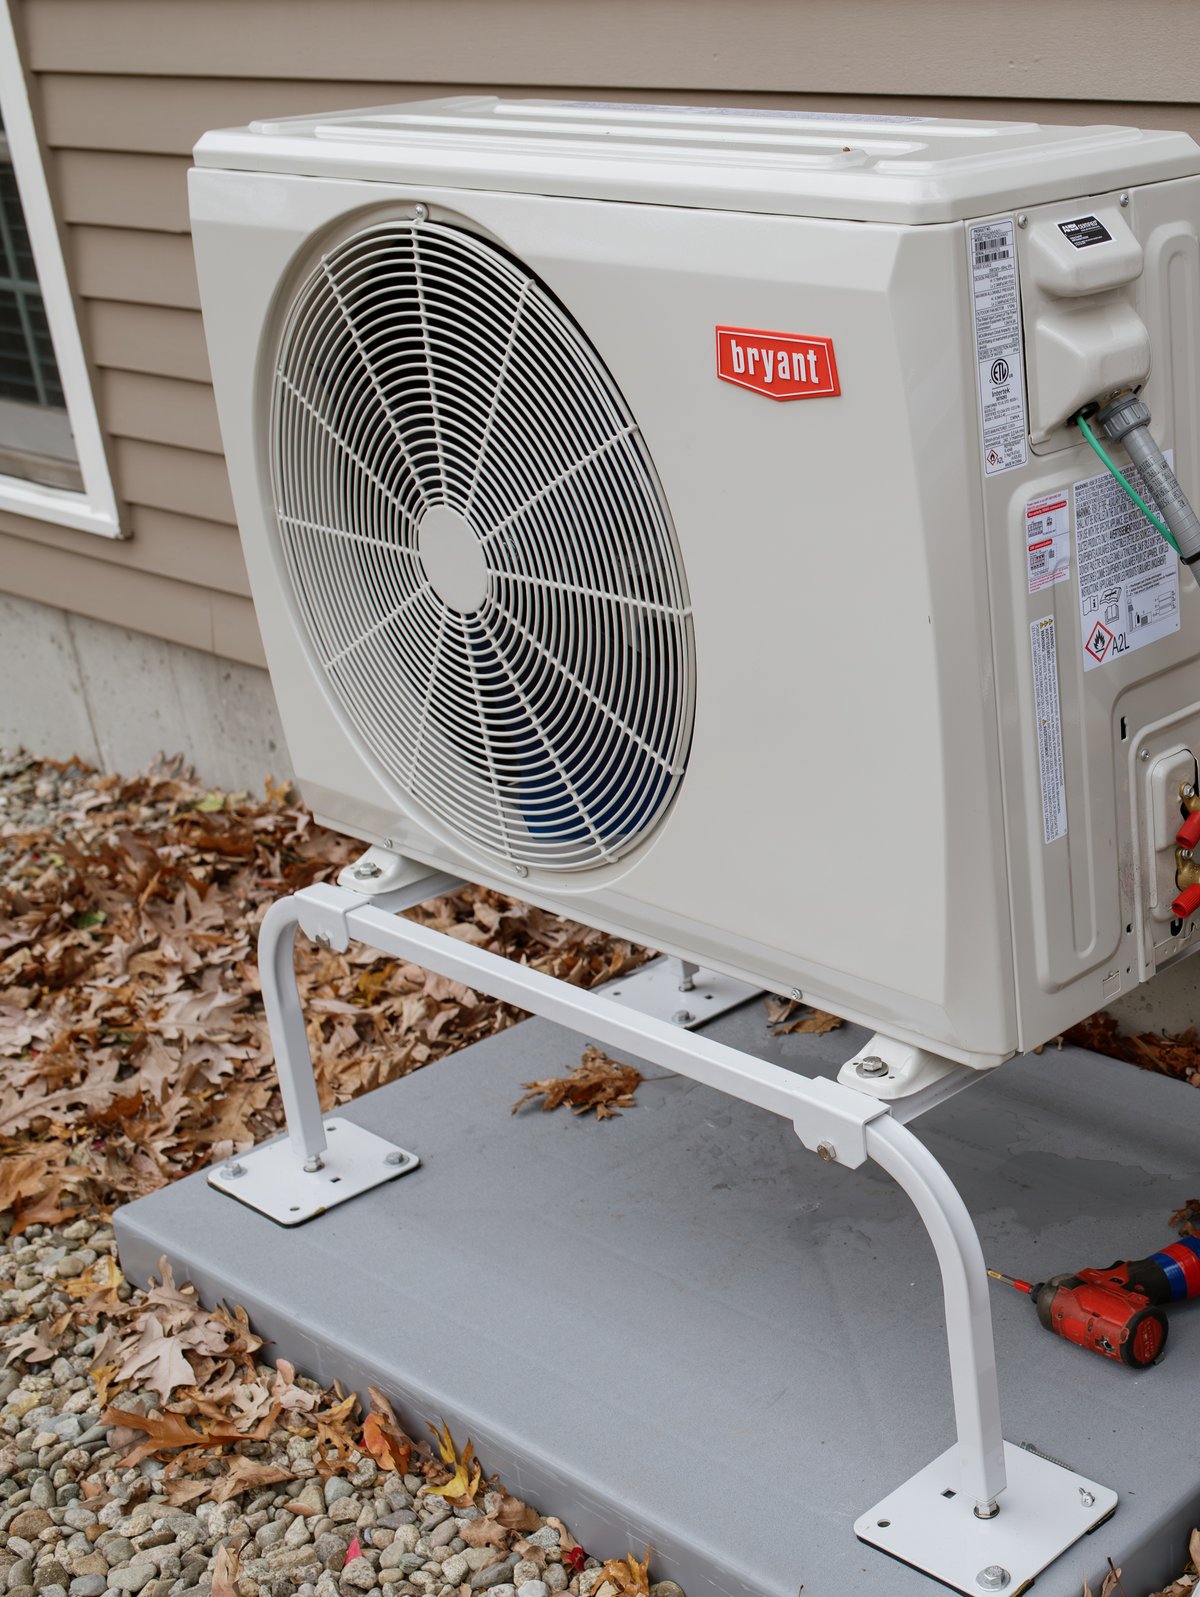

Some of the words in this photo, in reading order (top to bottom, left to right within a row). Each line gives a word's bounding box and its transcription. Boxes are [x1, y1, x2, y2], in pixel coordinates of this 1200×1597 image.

[730, 340, 818, 385] bryant
[992, 388, 1010, 397] Intertek
[1112, 632, 1130, 655] A2L
